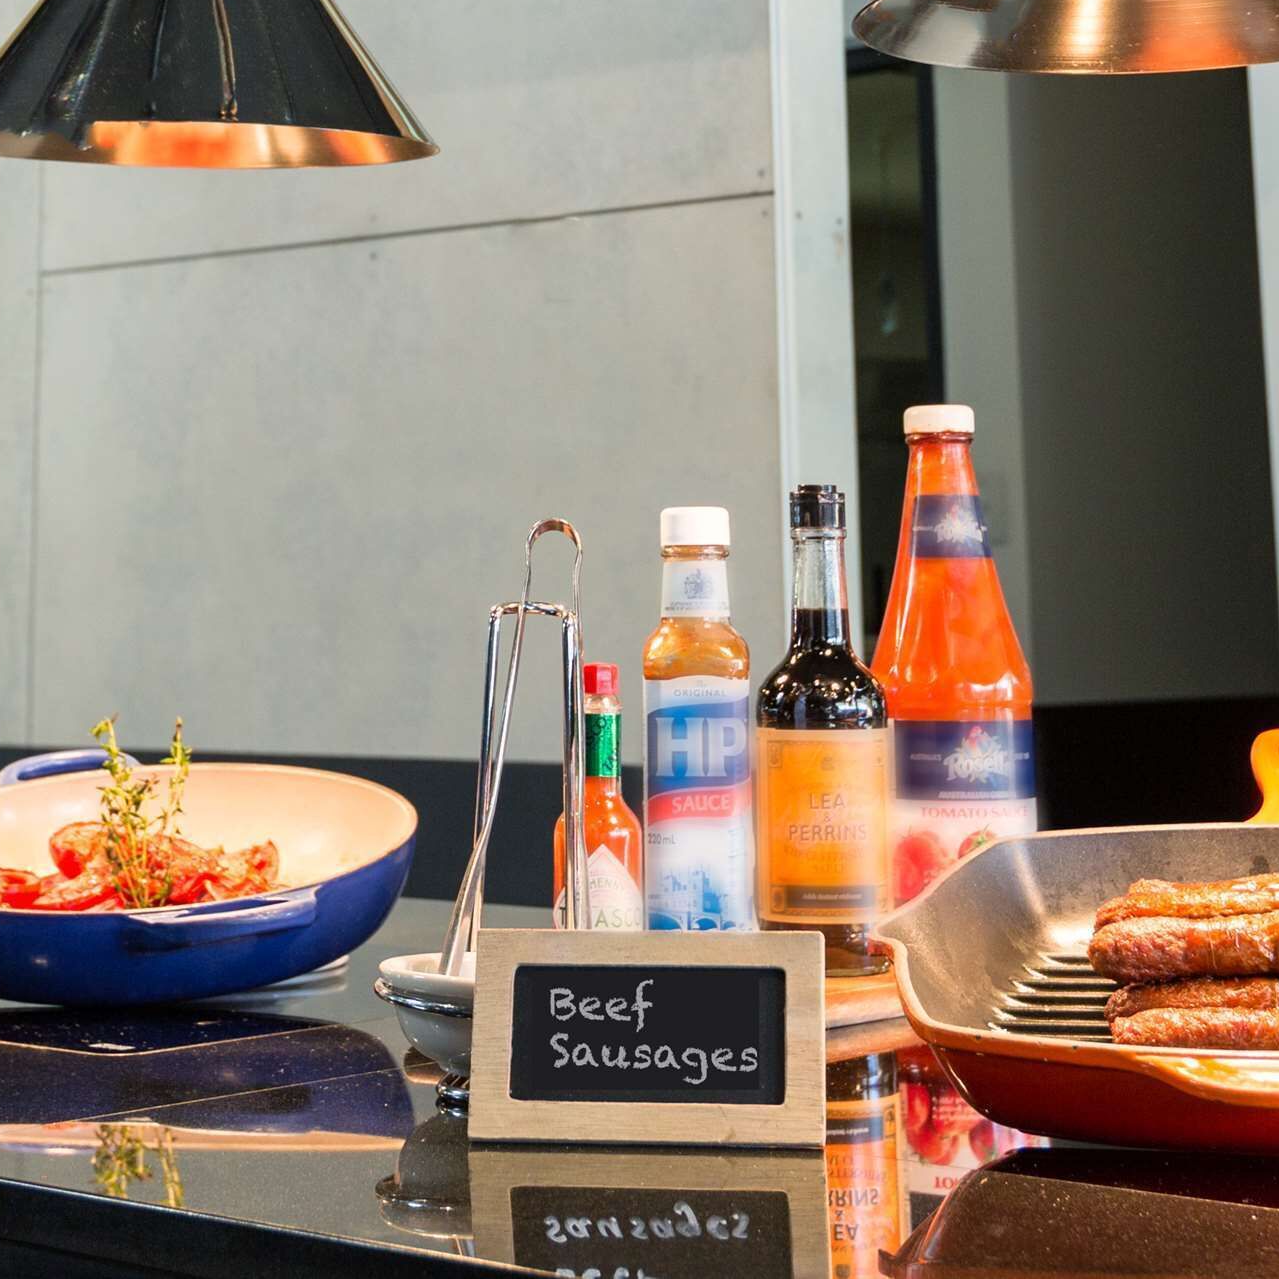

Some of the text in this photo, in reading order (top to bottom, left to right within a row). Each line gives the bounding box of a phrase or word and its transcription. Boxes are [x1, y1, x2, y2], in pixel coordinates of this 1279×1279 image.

[672, 688, 727, 697] ORIGINAL
[655, 716, 746, 777] HP
[671, 793, 731, 813] SAUCE
[808, 792, 846, 810] LEA
[920, 806, 988, 819] TOMATO
[788, 824, 867, 841] PERRINS
[549, 978, 655, 1032] Beef
[550, 1033, 759, 1085] Sausages
